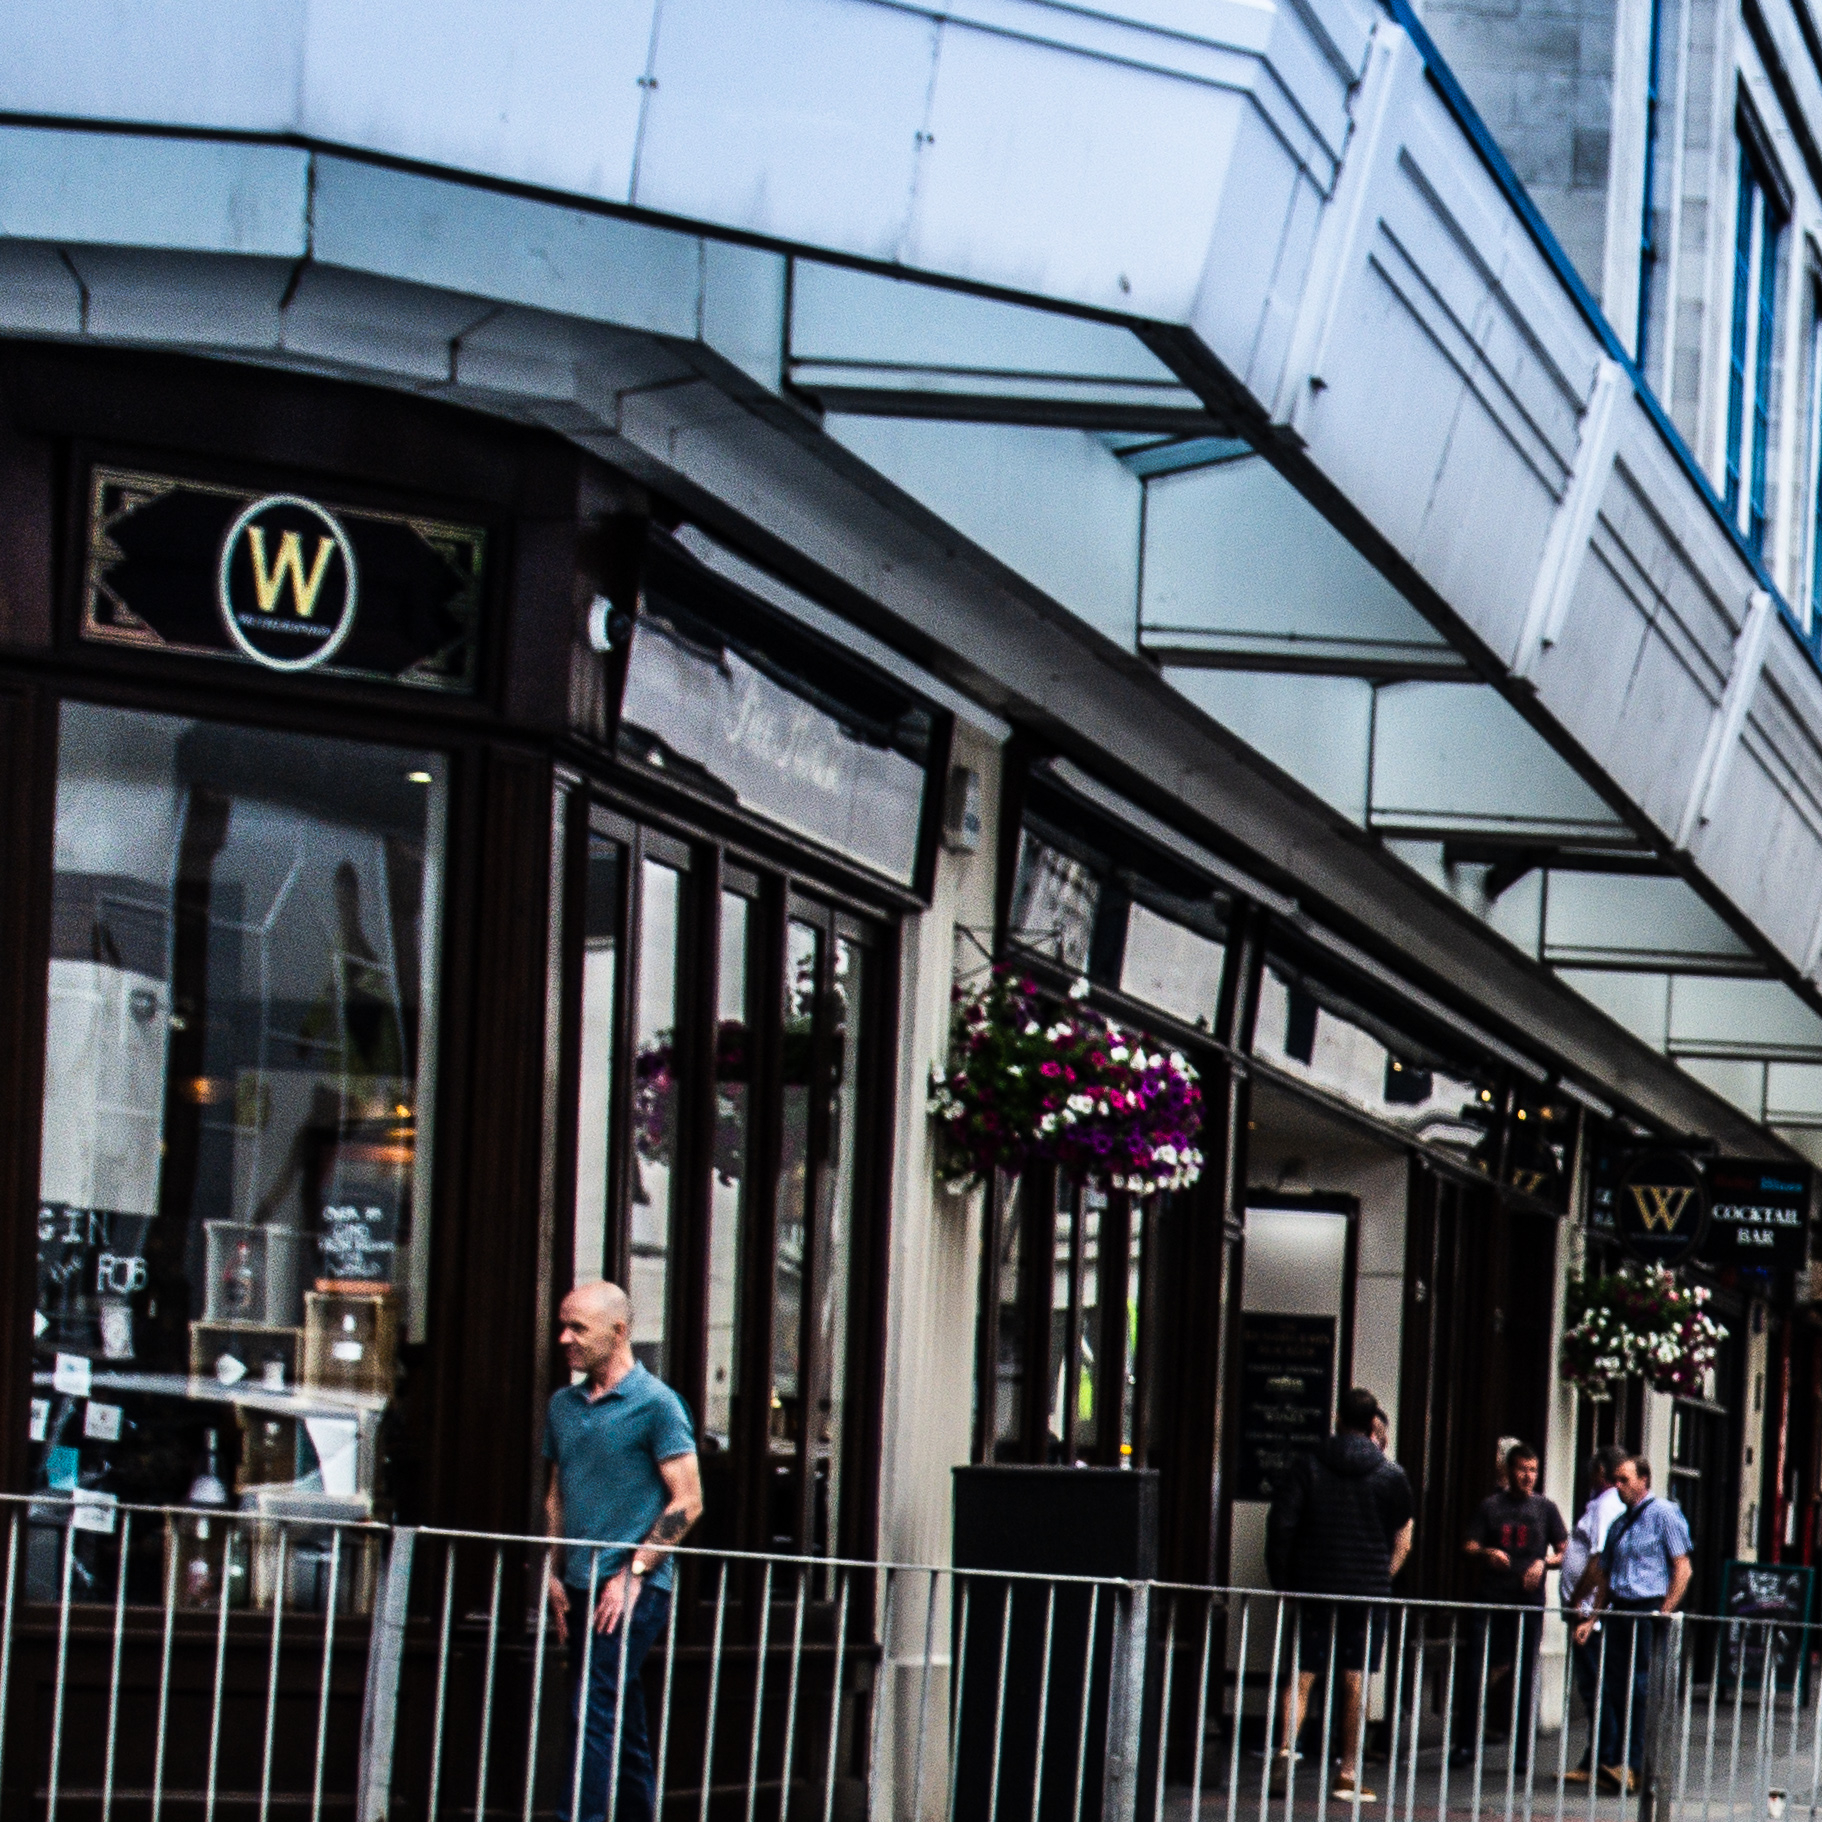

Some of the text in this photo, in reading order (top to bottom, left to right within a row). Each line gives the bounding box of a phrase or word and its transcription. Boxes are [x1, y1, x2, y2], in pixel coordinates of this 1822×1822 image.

[247, 525, 336, 618] W
[1628, 1184, 1695, 1231] W
[1712, 1203, 1800, 1226] COCKTAIL
[1737, 1228, 1774, 1247] BAR
